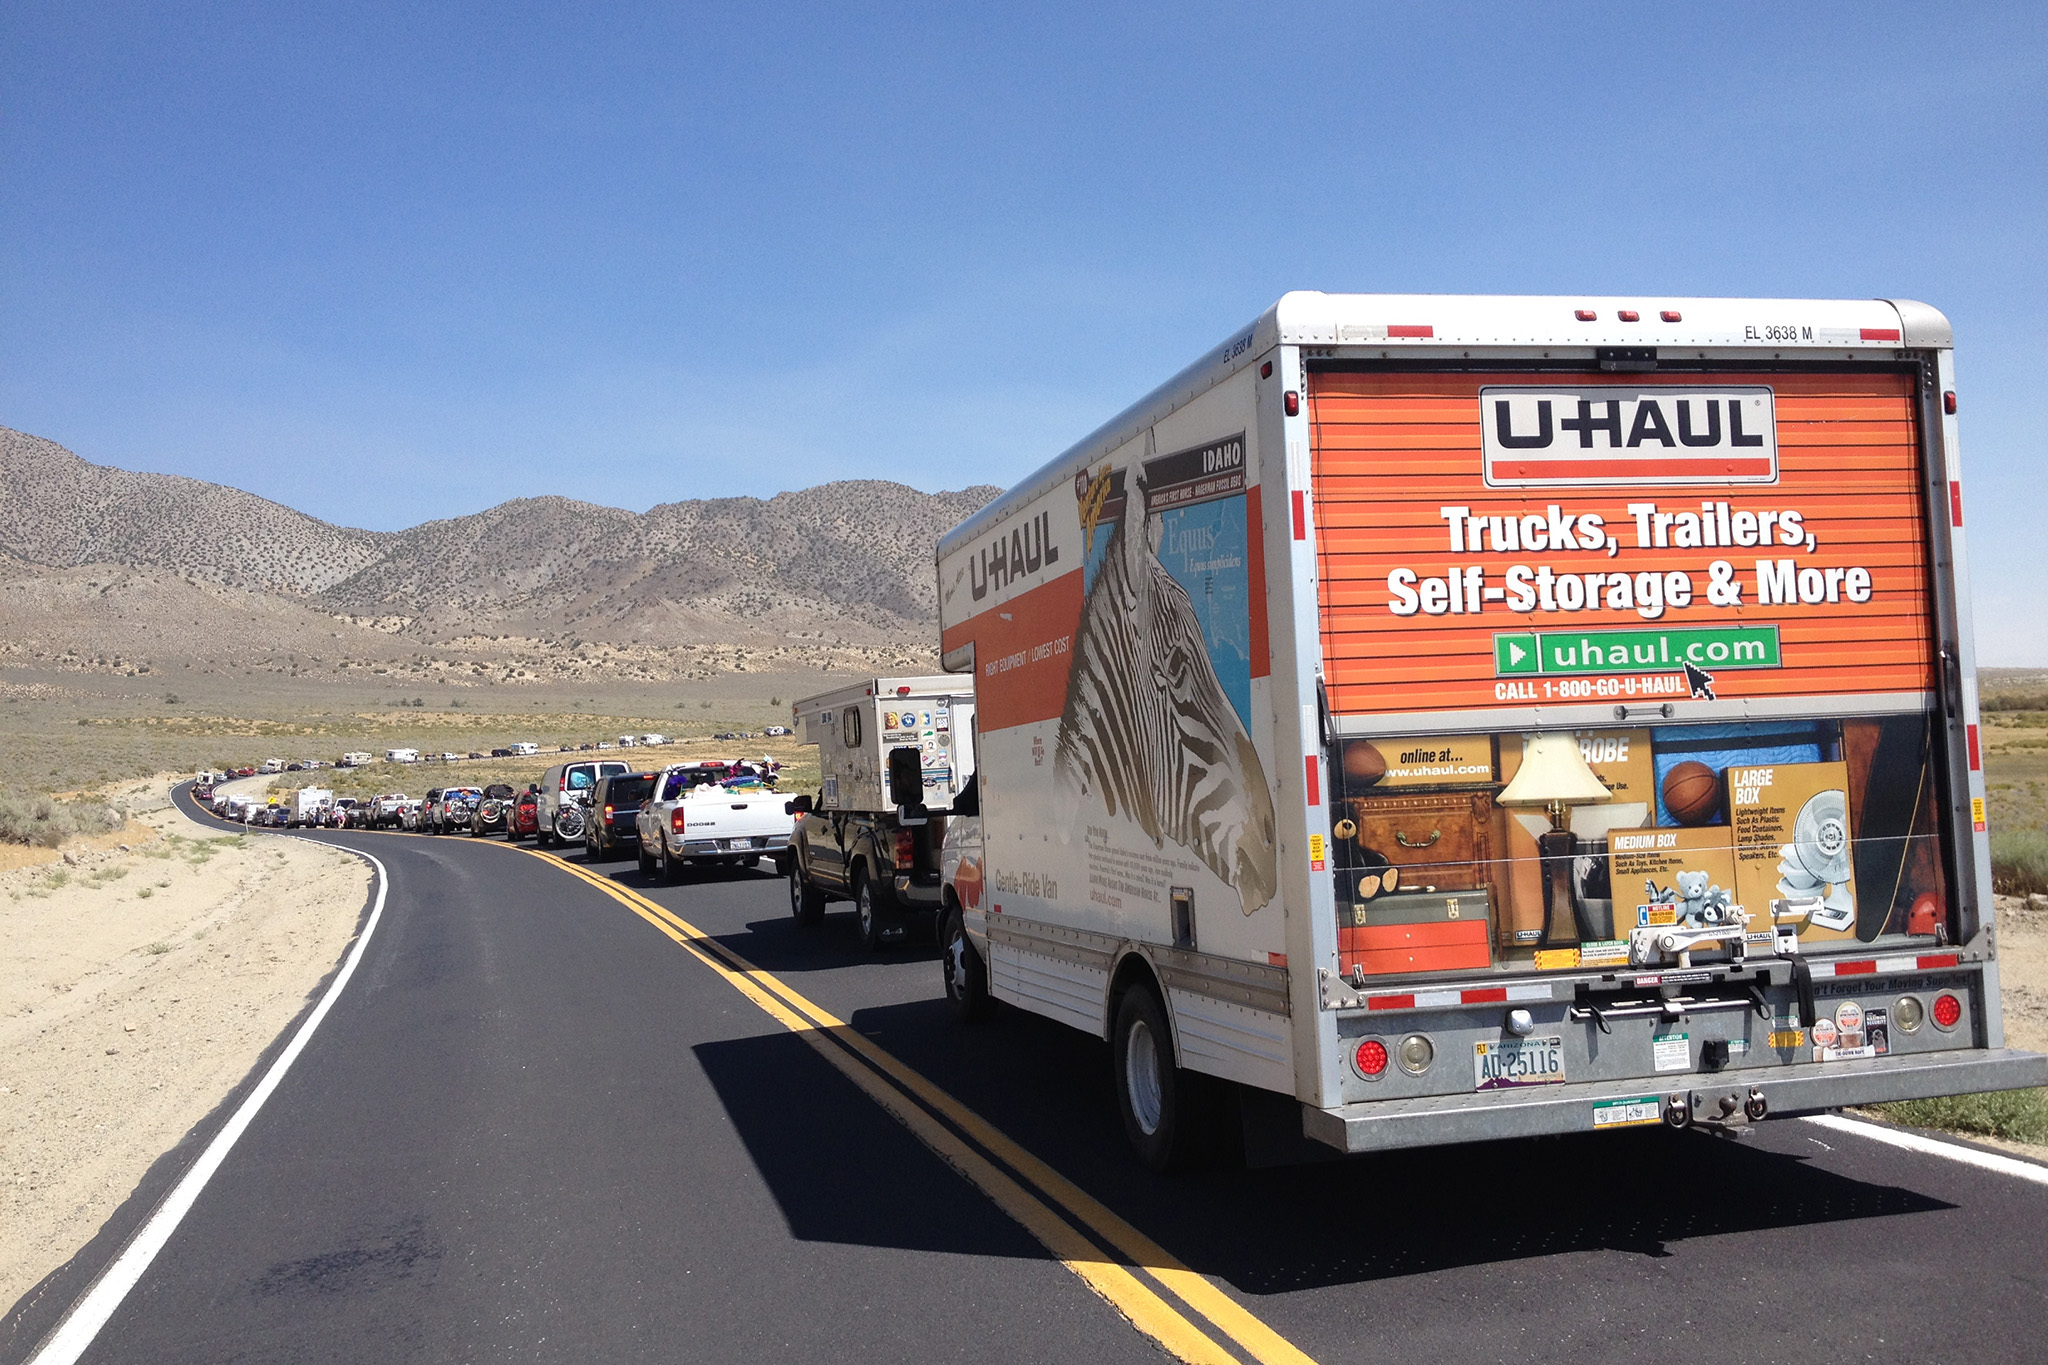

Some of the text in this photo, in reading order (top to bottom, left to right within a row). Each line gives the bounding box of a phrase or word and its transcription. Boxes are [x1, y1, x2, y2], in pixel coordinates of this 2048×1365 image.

[1745, 325, 1813, 340] EL 3638 M
[1495, 399, 1764, 449] U-HAUL
[1202, 441, 1241, 474] IDAHO
[1440, 501, 1817, 557] Trucks, Trailers,
[1167, 517, 1215, 573] Equus
[970, 511, 1059, 602] U-HAUL
[1387, 558, 1872, 619] Self-Storage & More
[1031, 641, 1053, 663] LOWEST
[1054, 635, 1070, 656] COST
[1554, 635, 1766, 667] uhaul.com
[1495, 676, 1685, 700] CALL 1-800-GO-U-HAUL
[1400, 748, 1463, 764] online at...
[1734, 768, 1773, 787] LARGE
[1735, 787, 1760, 805] BOX
[1736, 807, 1768, 817] Lightweight
[1736, 815, 1780, 825] Such As Plastic
[1737, 824, 1784, 833] Food Containers,
[1614, 833, 1677, 850] MEDIUM BOX
[1737, 834, 1776, 843] Lamp Shades,
[1615, 860, 1628, 868] Such
[1628, 860, 1635, 868] As
[1636, 859, 1648, 868] Toys,
[1649, 858, 1668, 866] Kitchen
[1738, 850, 1779, 861] Speakers, Etc.
[1615, 865, 1669, 876] Small Appliances, Etc.
[1041, 873, 1058, 900] Van
[1089, 887, 1122, 908] uhaul.com
[1636, 976, 1659, 985] DANGER
[1830, 982, 1861, 995] Forget
[1864, 981, 1886, 991] Your
[1888, 978, 1923, 990] Moving
[1497, 1041, 1541, 1049] ARIZONA
